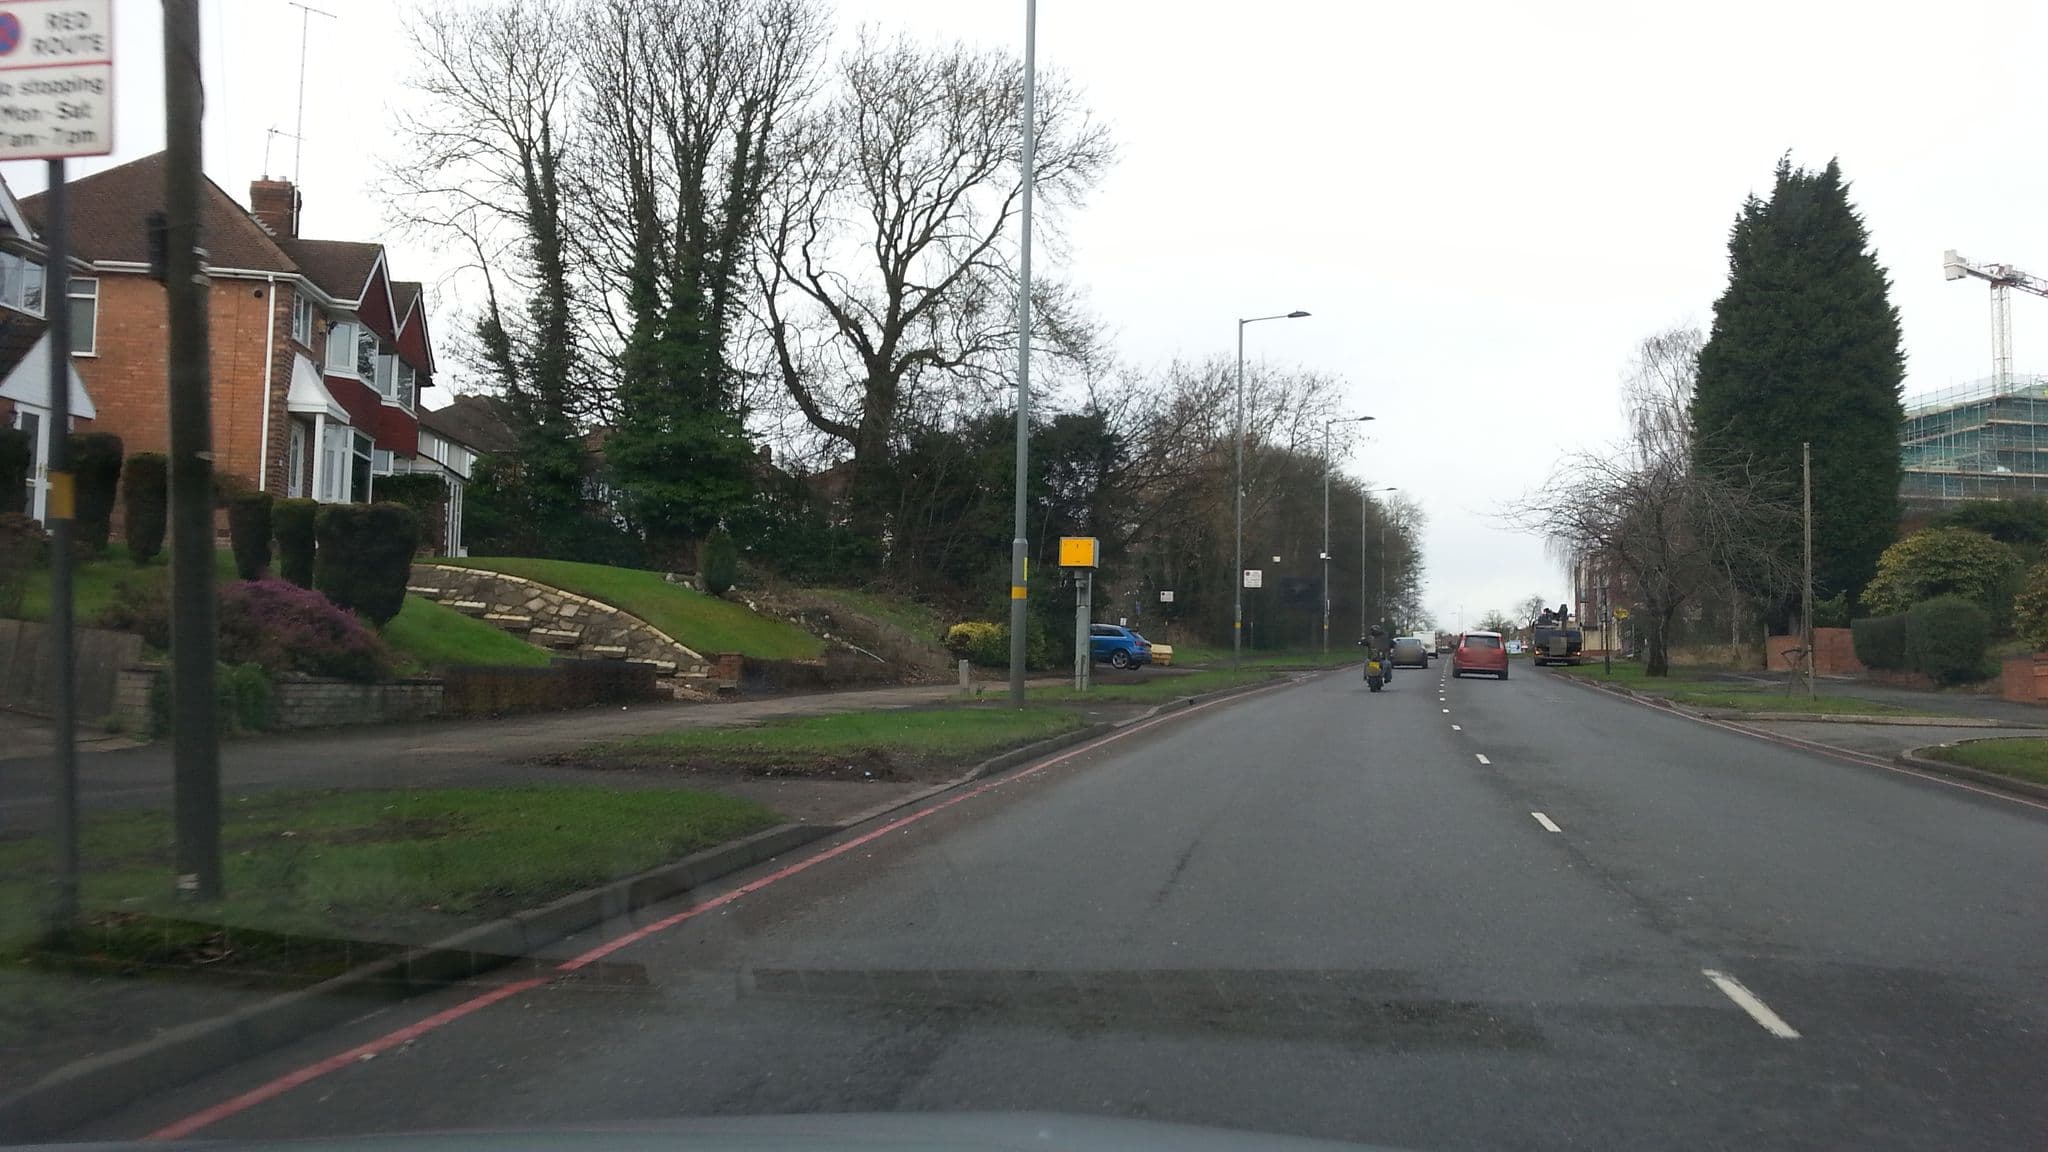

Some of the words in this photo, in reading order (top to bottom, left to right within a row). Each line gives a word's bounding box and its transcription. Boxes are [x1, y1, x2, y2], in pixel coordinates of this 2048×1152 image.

[47, 11, 89, 31] RED
[33, 33, 104, 55] ROUTE
[0, 82, 14, 96] o
[18, 75, 104, 96] stopping
